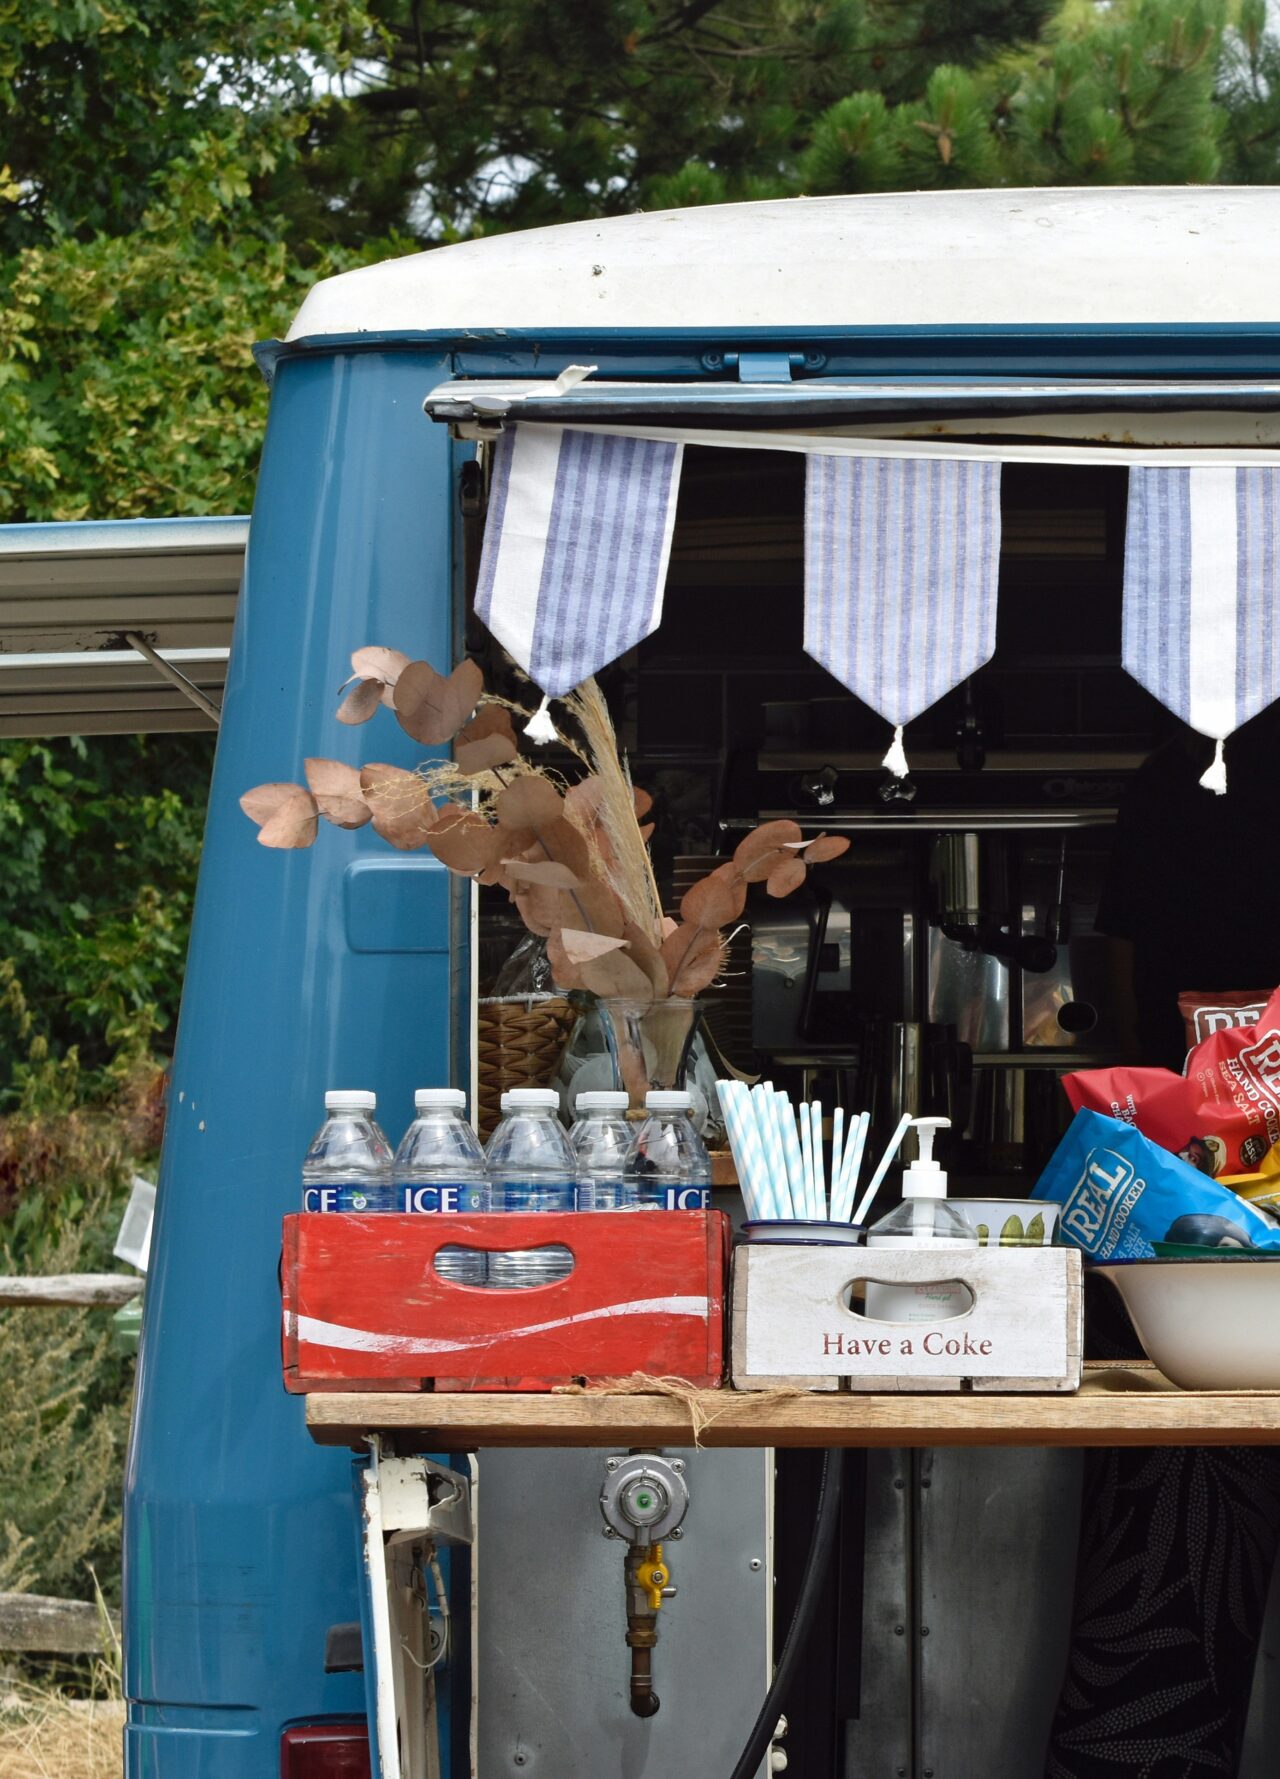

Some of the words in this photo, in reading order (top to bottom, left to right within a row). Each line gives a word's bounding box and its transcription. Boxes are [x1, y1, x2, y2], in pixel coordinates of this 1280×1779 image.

[1126, 1094, 1137, 1115] WITH
[1219, 1061, 1237, 1091] SEA
[1233, 1092, 1260, 1125] SALT
[1227, 1057, 1260, 1101] HAND
[1258, 1100, 1280, 1144] COOKE
[304, 1189, 338, 1213] CE
[405, 1188, 458, 1213] ICE
[1066, 1161, 1127, 1244] REAL
[1099, 1223, 1121, 1260] HAND
[1113, 1177, 1147, 1230] COOKED
[1122, 1222, 1141, 1251] SALT
[1128, 1236, 1147, 1260] DER
[822, 1333, 891, 1356] Have
[900, 1340, 913, 1356] a
[923, 1332, 993, 1356] Coke
